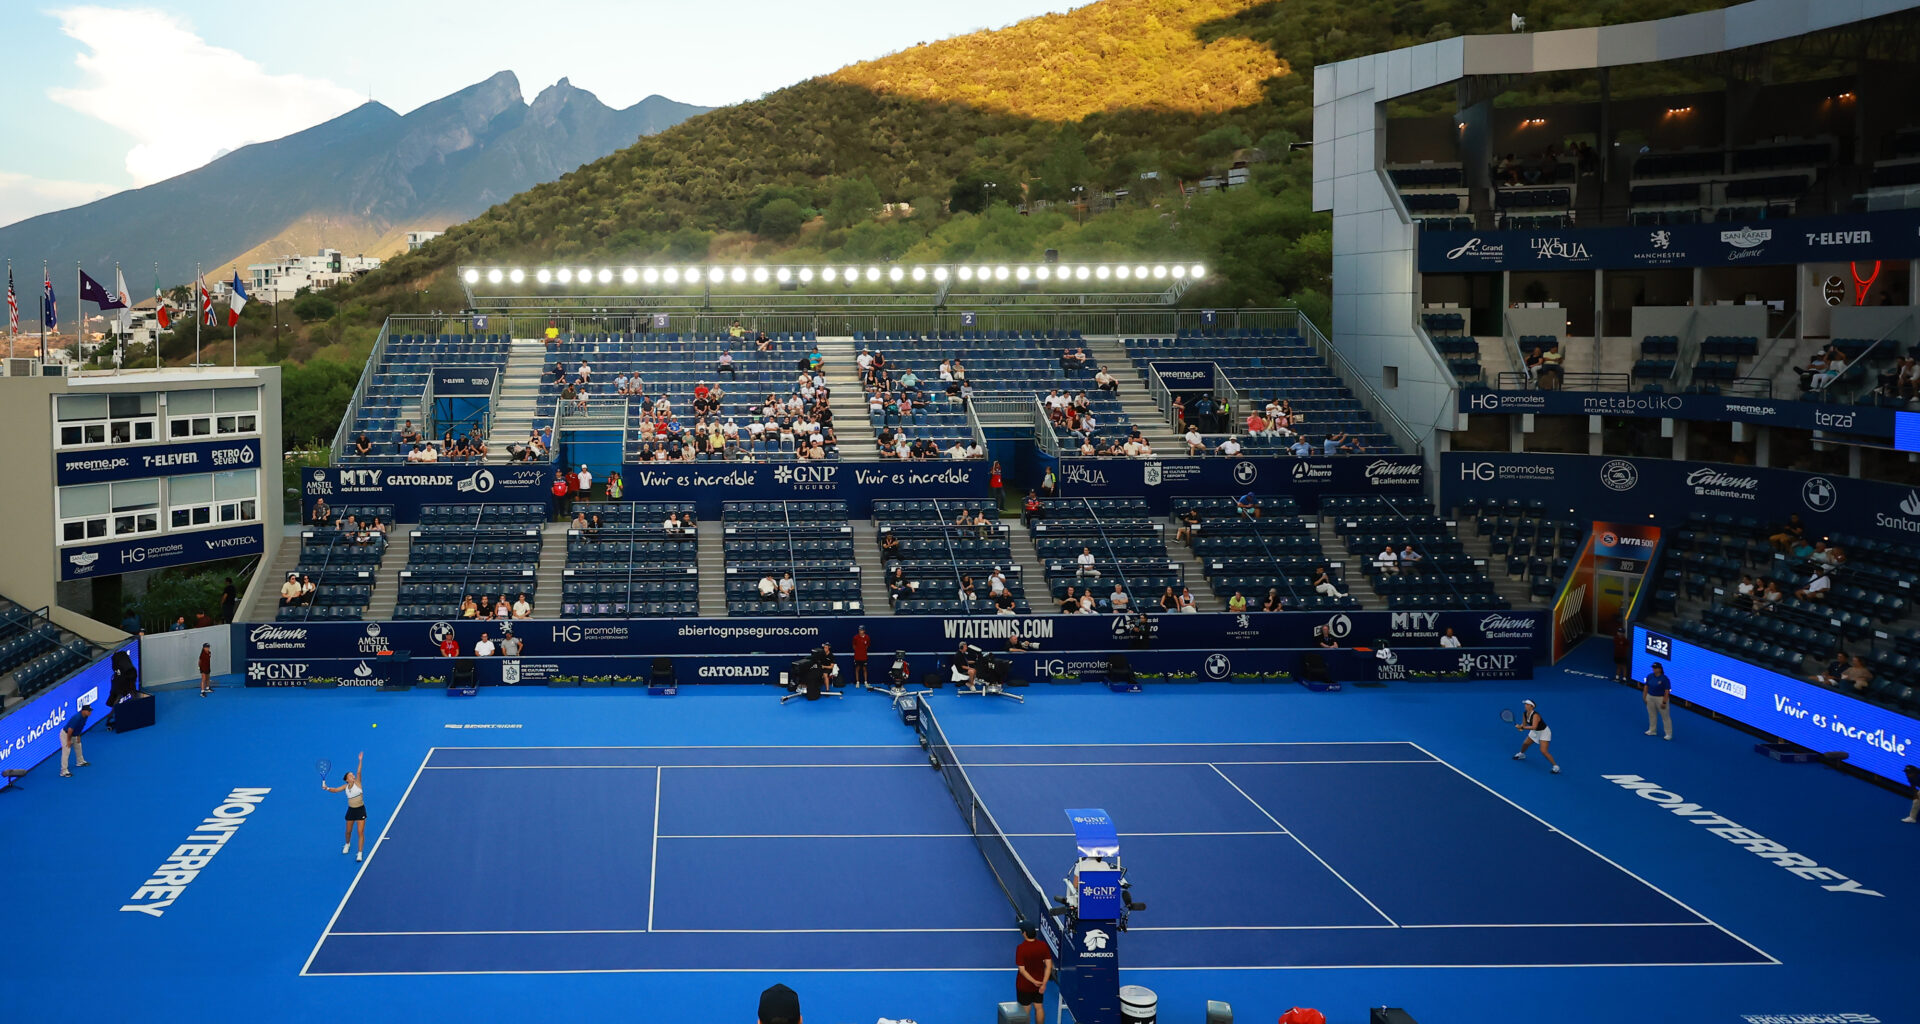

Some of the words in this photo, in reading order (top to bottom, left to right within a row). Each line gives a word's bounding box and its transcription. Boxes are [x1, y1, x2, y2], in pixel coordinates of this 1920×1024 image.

[1724, 231, 1739, 240] SAN
[1740, 231, 1769, 240] RAFAEL
[1531, 238, 1561, 249] LIVE
[1537, 243, 1589, 259] AQUA
[1728, 249, 1765, 261] Balance
[477, 318, 484, 327] 4
[658, 317, 665, 326] 3
[965, 315, 972, 324] 2
[1471, 394, 1498, 409] HG
[1501, 395, 1545, 405] promoters
[1815, 409, 1853, 428] terza
[142, 452, 198, 468] 7-ELEVEN
[211, 449, 240, 459] PETRO
[213, 457, 239, 466] SEVEN
[793, 466, 836, 482] GNP
[1062, 464, 1085, 475] LIVE
[1307, 469, 1332, 477] Ahorro
[1365, 459, 1422, 478] Caliente
[1461, 462, 1495, 481] HG
[1499, 464, 1555, 475] promoters
[340, 469, 382, 486] MTY
[386, 475, 453, 486] GATORADE
[640, 471, 674, 487] Vivir
[677, 475, 690, 486] es
[693, 470, 755, 486] increíble
[855, 469, 889, 485] Vivir
[891, 474, 905, 484] es
[908, 469, 970, 485] increíble
[1067, 470, 1108, 483] AQUA
[1686, 467, 1759, 489] Caliente
[306, 481, 333, 489] AMSTEL
[1705, 488, 1755, 500] caliente.mx
[214, 536, 255, 548] VINOTECA
[1620, 536, 1641, 547] WTA
[1641, 538, 1654, 548] 500
[121, 547, 146, 564] HG
[147, 544, 184, 555] promoters
[1391, 612, 1440, 630] MTY
[1480, 613, 1536, 632] Caliente
[250, 624, 308, 643] Caliente
[552, 625, 581, 643] HG
[584, 626, 628, 637] promoters
[678, 624, 819, 638] abiertognpseguros.com
[943, 619, 1053, 639] WTATENNIS.COM
[358, 637, 389, 646] AMSTEL
[1647, 636, 1668, 652] 1:32
[359, 645, 389, 653] ULTRA
[1035, 659, 1064, 677] HG
[1067, 660, 1112, 670] promoter
[1378, 664, 1405, 673] AMSTEL
[1476, 654, 1515, 670] GNP
[266, 663, 307, 678] GNP
[698, 666, 770, 677] GATORADE
[1378, 672, 1406, 680] ULTRA
[337, 677, 389, 687] Santande
[1713, 677, 1732, 692] WTA
[15, 735, 26, 750] es
[27, 706, 66, 744] increíble
[1774, 693, 1809, 720] Vivir
[1812, 713, 1827, 729] es
[1831, 714, 1906, 757] increíble
[1600, 774, 1887, 898] MONTERREY
[119, 787, 273, 918] MONTERREY
[1093, 886, 1115, 896] GNP
